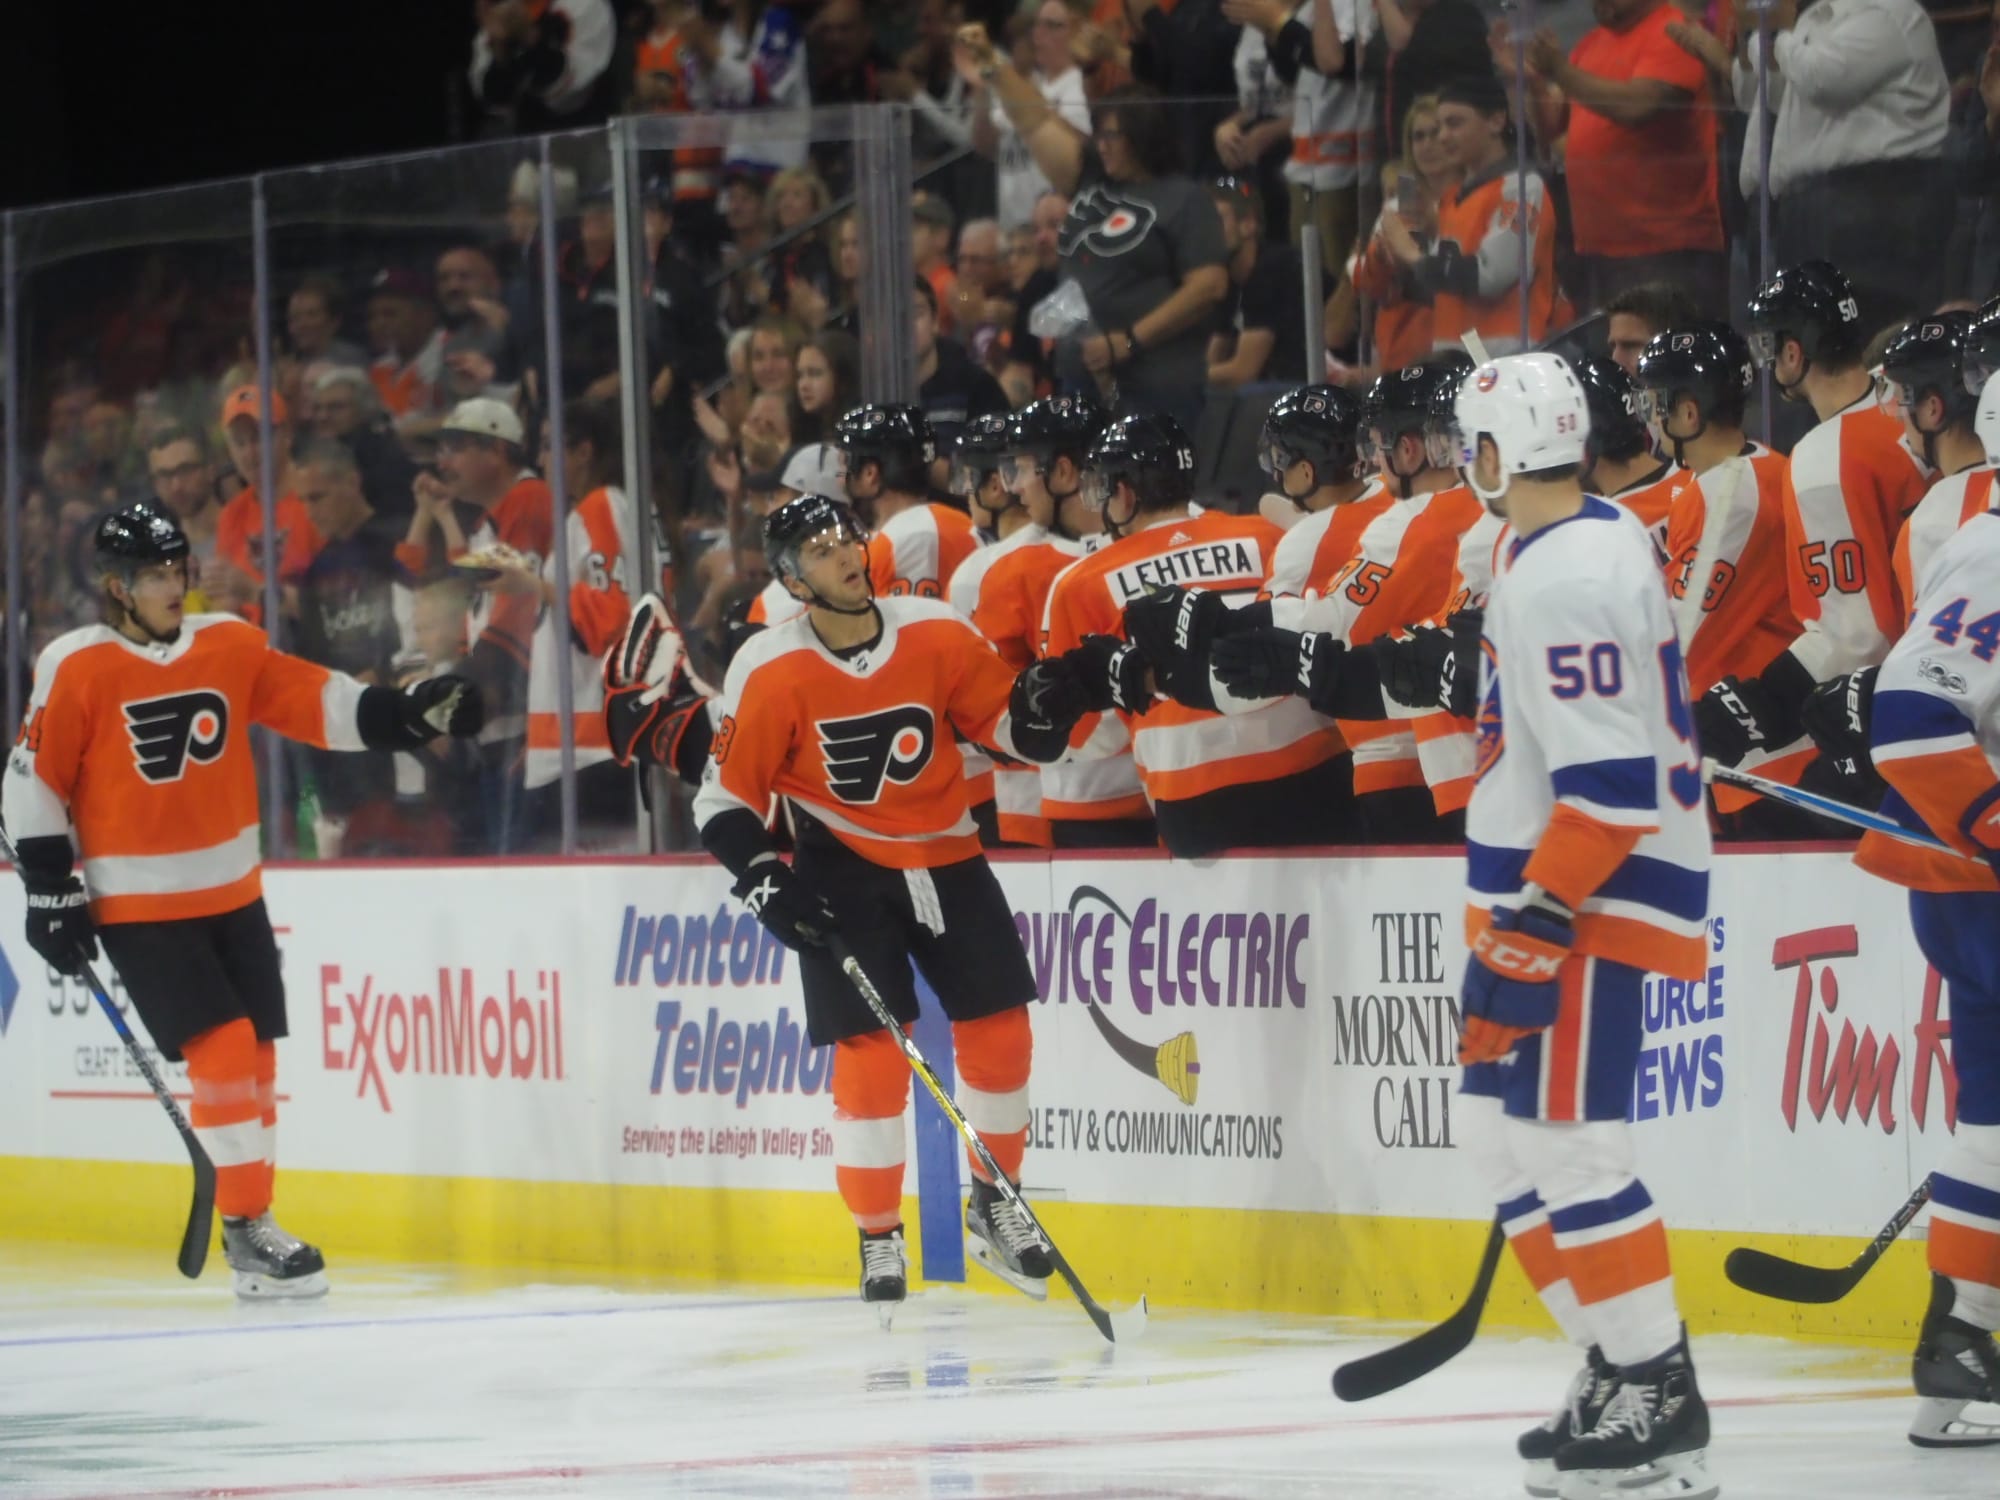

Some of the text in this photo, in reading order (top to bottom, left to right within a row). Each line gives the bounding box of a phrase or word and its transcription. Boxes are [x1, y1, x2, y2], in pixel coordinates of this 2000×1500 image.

[1838, 298, 1859, 322] 50
[1556, 413, 1577, 434] 50
[1176, 448, 1194, 470] 15
[1117, 543, 1253, 598] LEHTERA
[1799, 539, 1866, 598] 50
[1929, 597, 2000, 663] 44
[1546, 641, 1623, 701] 50
[614, 904, 785, 988] Ironton
[1372, 912, 1445, 984] THE
[320, 963, 564, 1113] ExxonMobil
[650, 1001, 833, 1109] Telepho
[1772, 924, 1901, 1135] Tim
[622, 1125, 676, 1158] Serving
[680, 1126, 705, 1154] the
[708, 1126, 757, 1159] Lehigh
[763, 1128, 807, 1160] Valley
[1058, 1108, 1083, 1151] TV
[1086, 1109, 1100, 1151] &
[1104, 1110, 1283, 1160] COMMUNICATIONS
